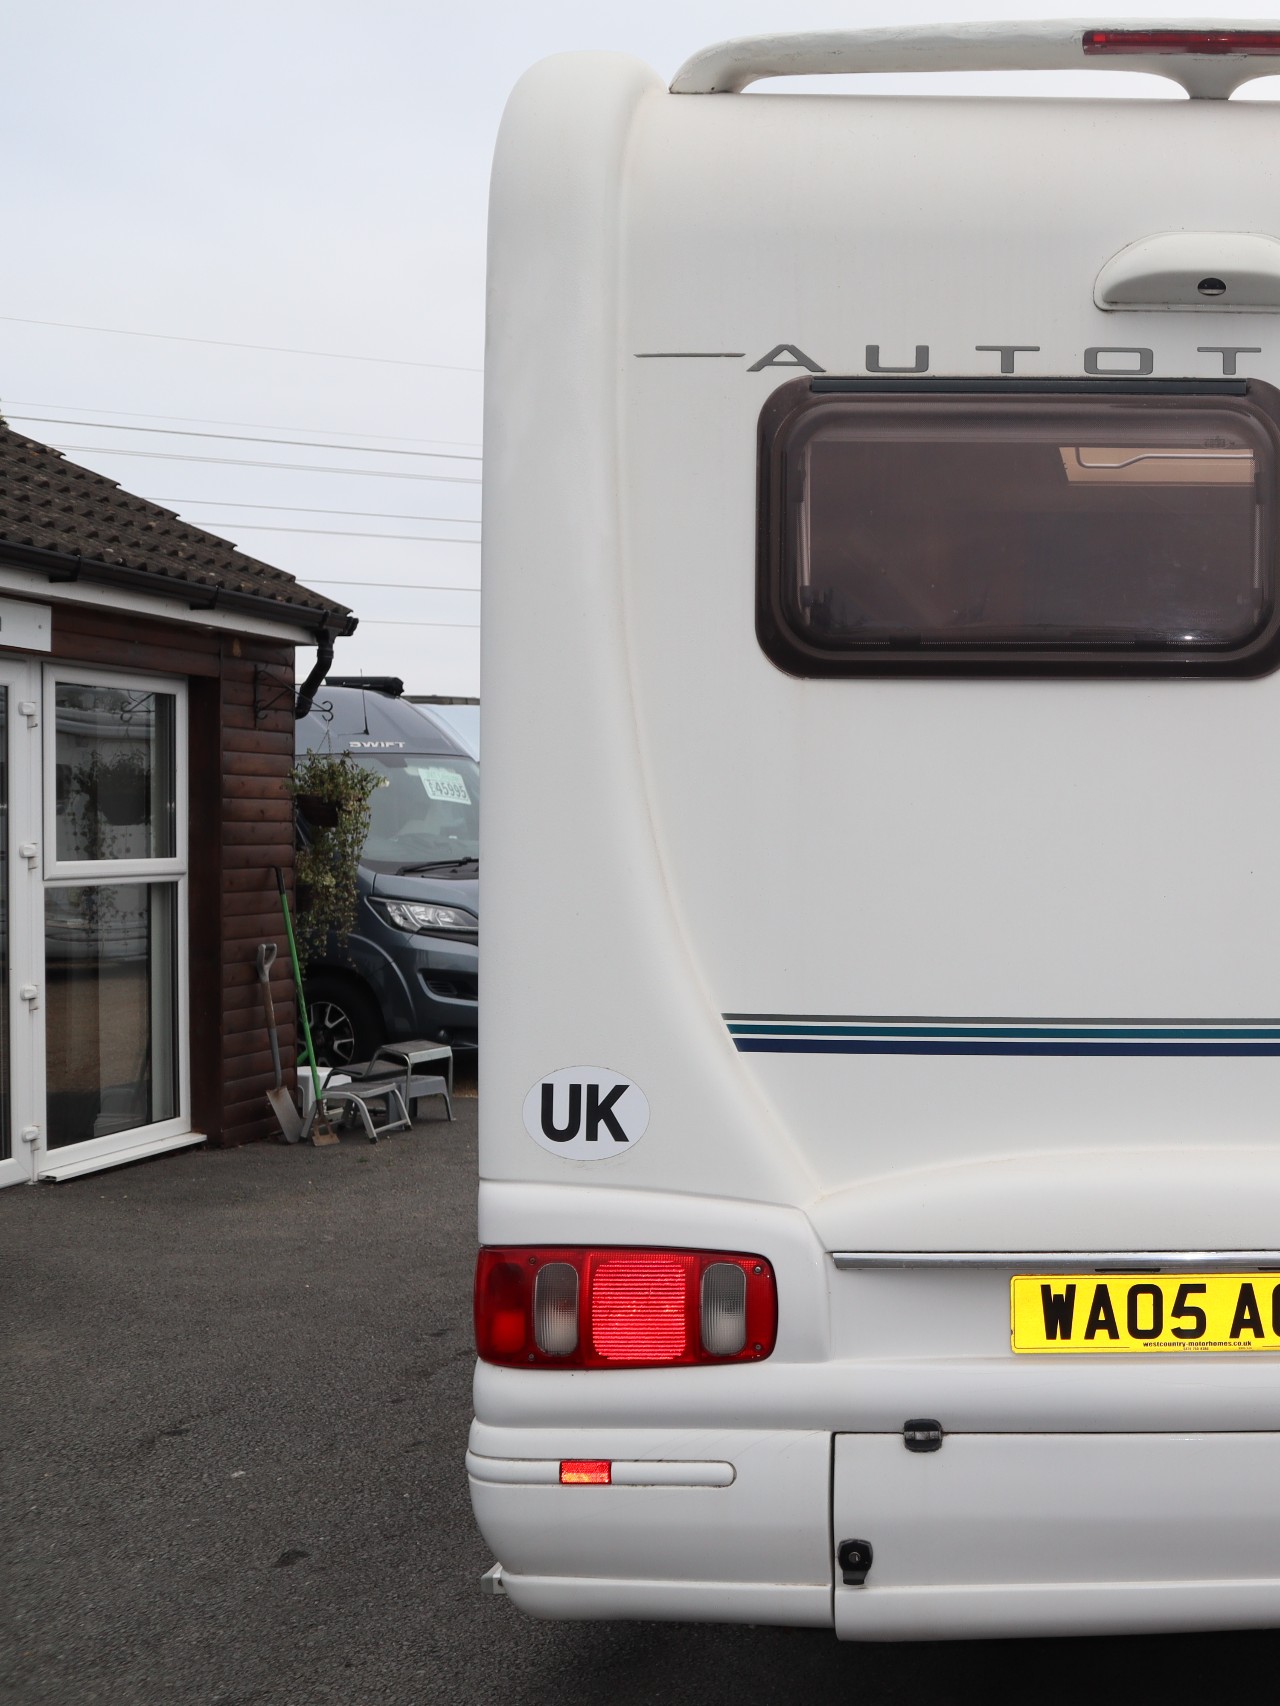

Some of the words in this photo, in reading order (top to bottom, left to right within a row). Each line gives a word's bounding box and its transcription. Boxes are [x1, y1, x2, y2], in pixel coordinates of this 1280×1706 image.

[541, 1083, 630, 1142] UK
[1041, 1284, 1206, 1340] WA05
[1142, 1340, 1252, 1348] westcountry-motorhomes.co.uk
